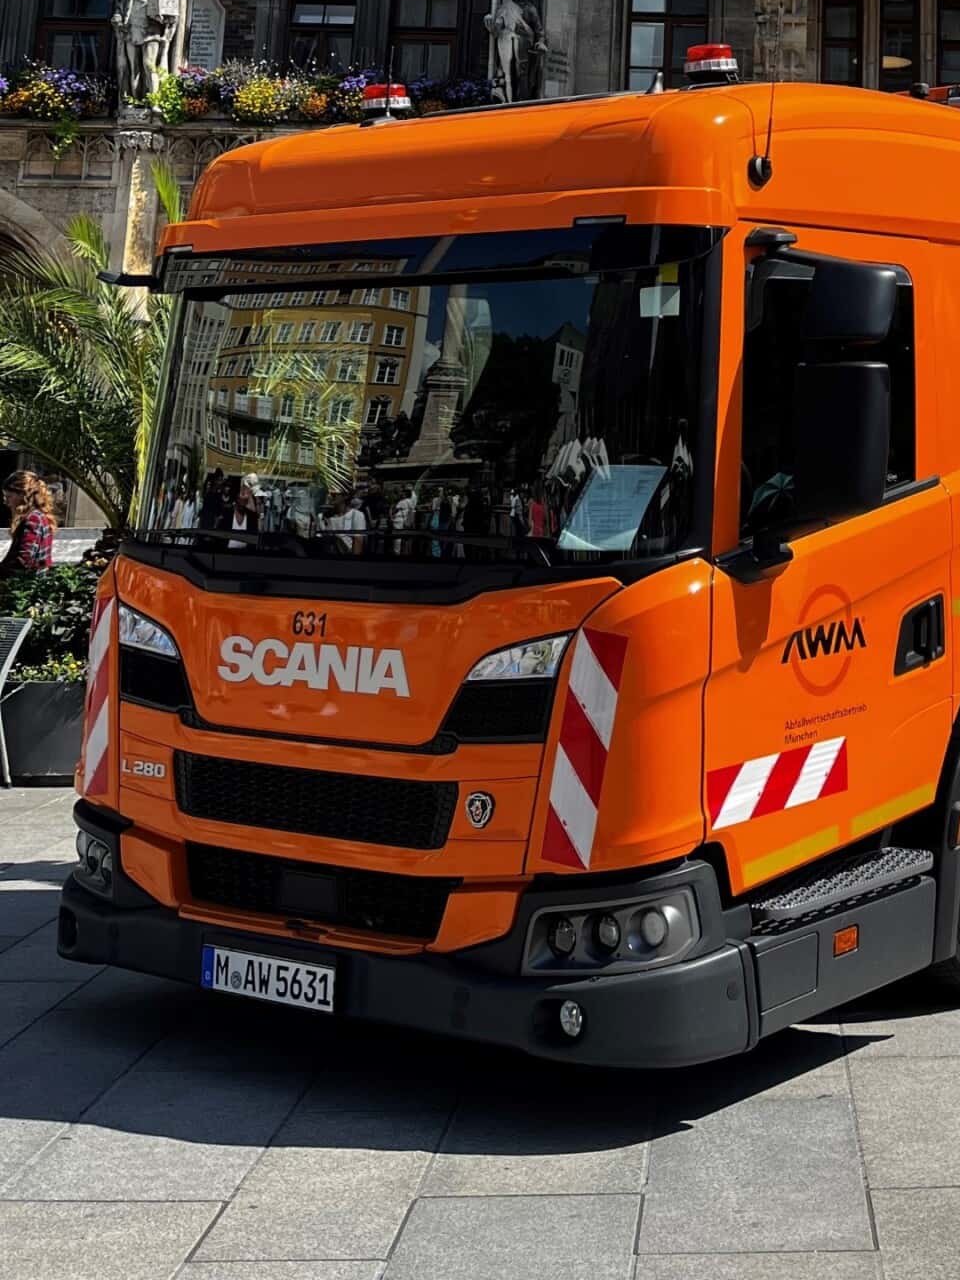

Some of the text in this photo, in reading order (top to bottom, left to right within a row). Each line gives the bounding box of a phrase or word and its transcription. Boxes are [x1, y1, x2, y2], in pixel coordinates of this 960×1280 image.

[292, 610, 328, 638] 631
[781, 617, 867, 664] AWM
[216, 634, 411, 698] SCANIA
